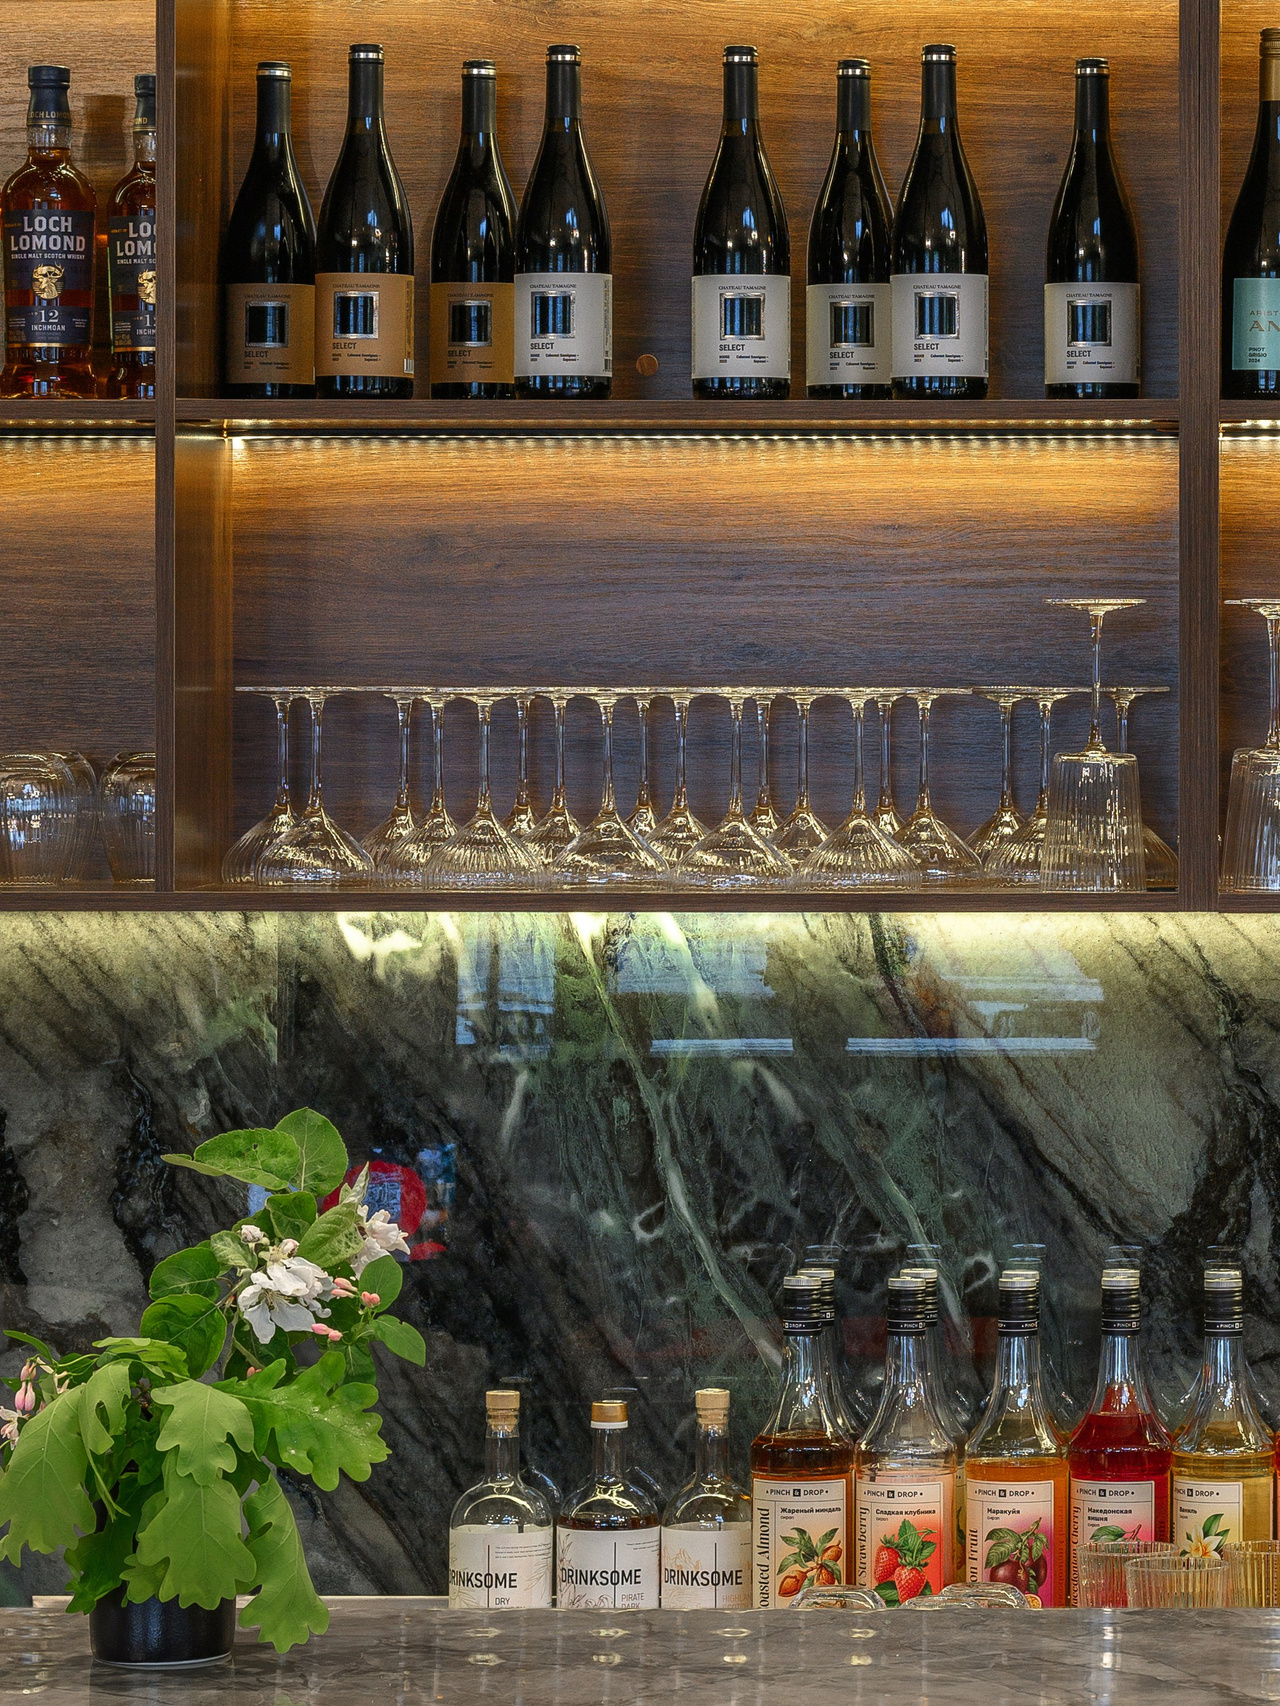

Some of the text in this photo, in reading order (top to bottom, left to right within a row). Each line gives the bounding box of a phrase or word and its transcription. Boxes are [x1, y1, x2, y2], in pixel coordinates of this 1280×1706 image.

[23, 216, 72, 232] LOCH
[128, 222, 155, 238] LO
[10, 235, 86, 251] LOMOND
[116, 241, 155, 256] LOM
[39, 309, 59, 322] 12
[332, 342, 357, 350] SELECT
[530, 342, 554, 350] SELECT
[1067, 350, 1091, 358] SELECT
[904, 1508, 936, 1516] клубника
[1088, 1507, 1132, 1515] Македонская
[1179, 1506, 1197, 1514] Ваниль
[1071, 1506, 1081, 1545] Cherry
[858, 1507, 870, 1577] Strawberry
[969, 1528, 978, 1561] Fruit
[757, 1507, 770, 1607] oasted Almond
[561, 1567, 641, 1586] DRINKSOME
[665, 1568, 743, 1586] DRINKSOME
[621, 1593, 644, 1601] PIRATE
[723, 1593, 751, 1602] HIGHLAN
